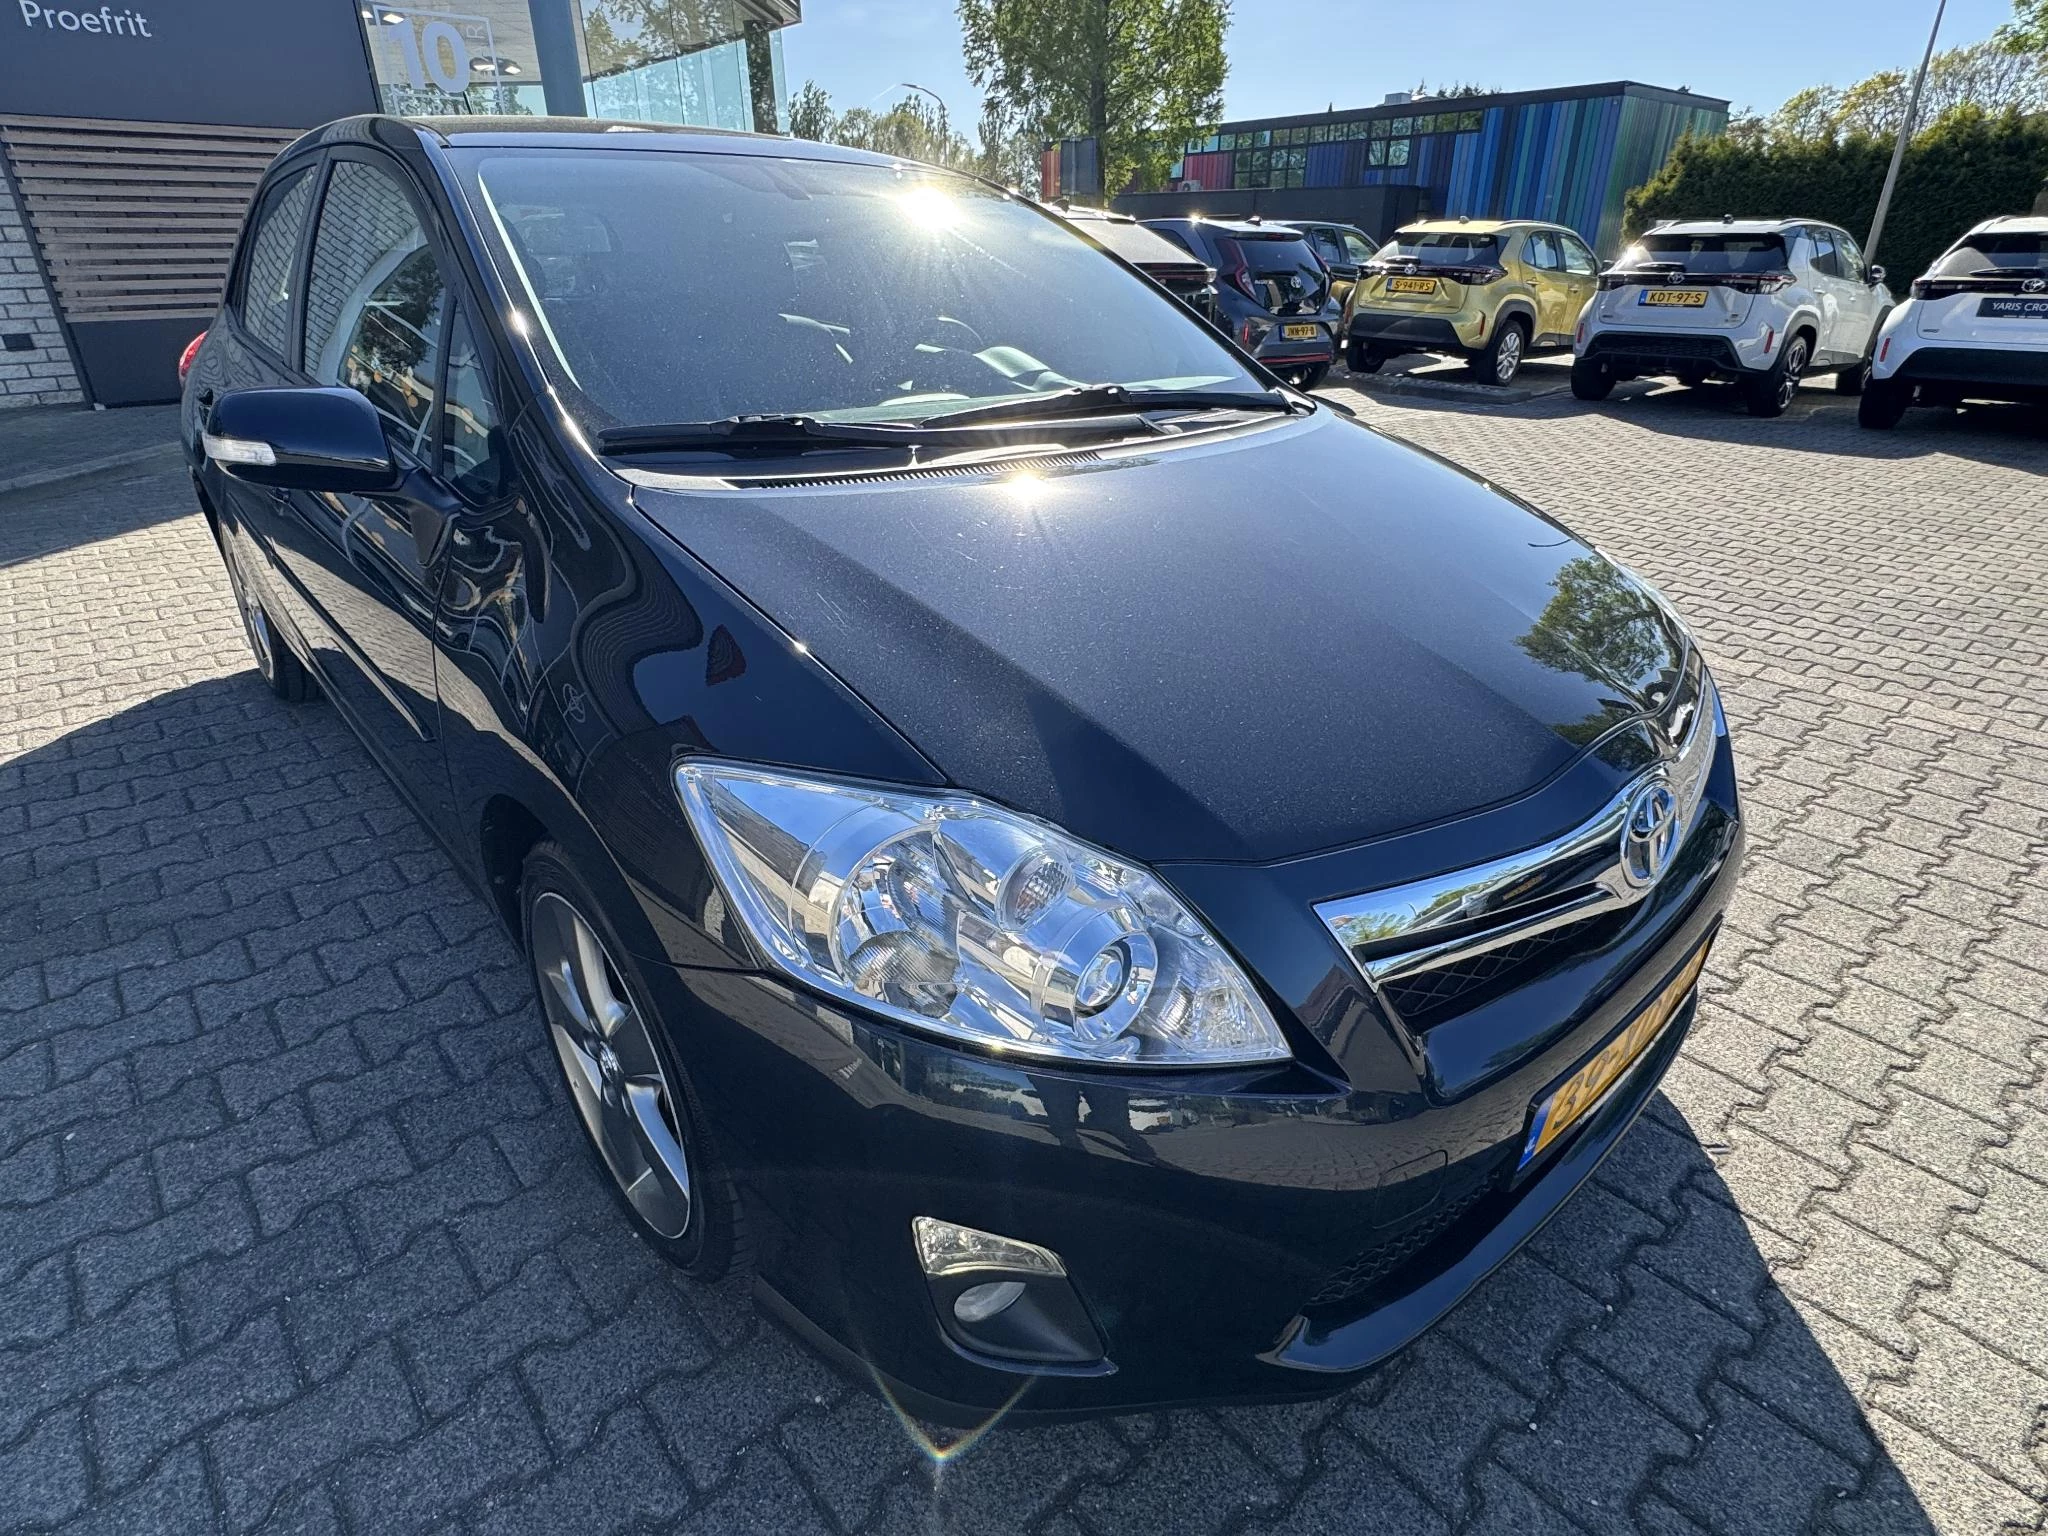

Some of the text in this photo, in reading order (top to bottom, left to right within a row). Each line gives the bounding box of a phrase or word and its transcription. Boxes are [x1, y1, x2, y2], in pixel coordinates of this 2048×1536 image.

[19, 0, 153, 38] Proefrit
[388, 16, 470, 94] 10
[1649, 291, 1702, 303] KDT-97-S
[1992, 302, 2022, 311] YARIS
